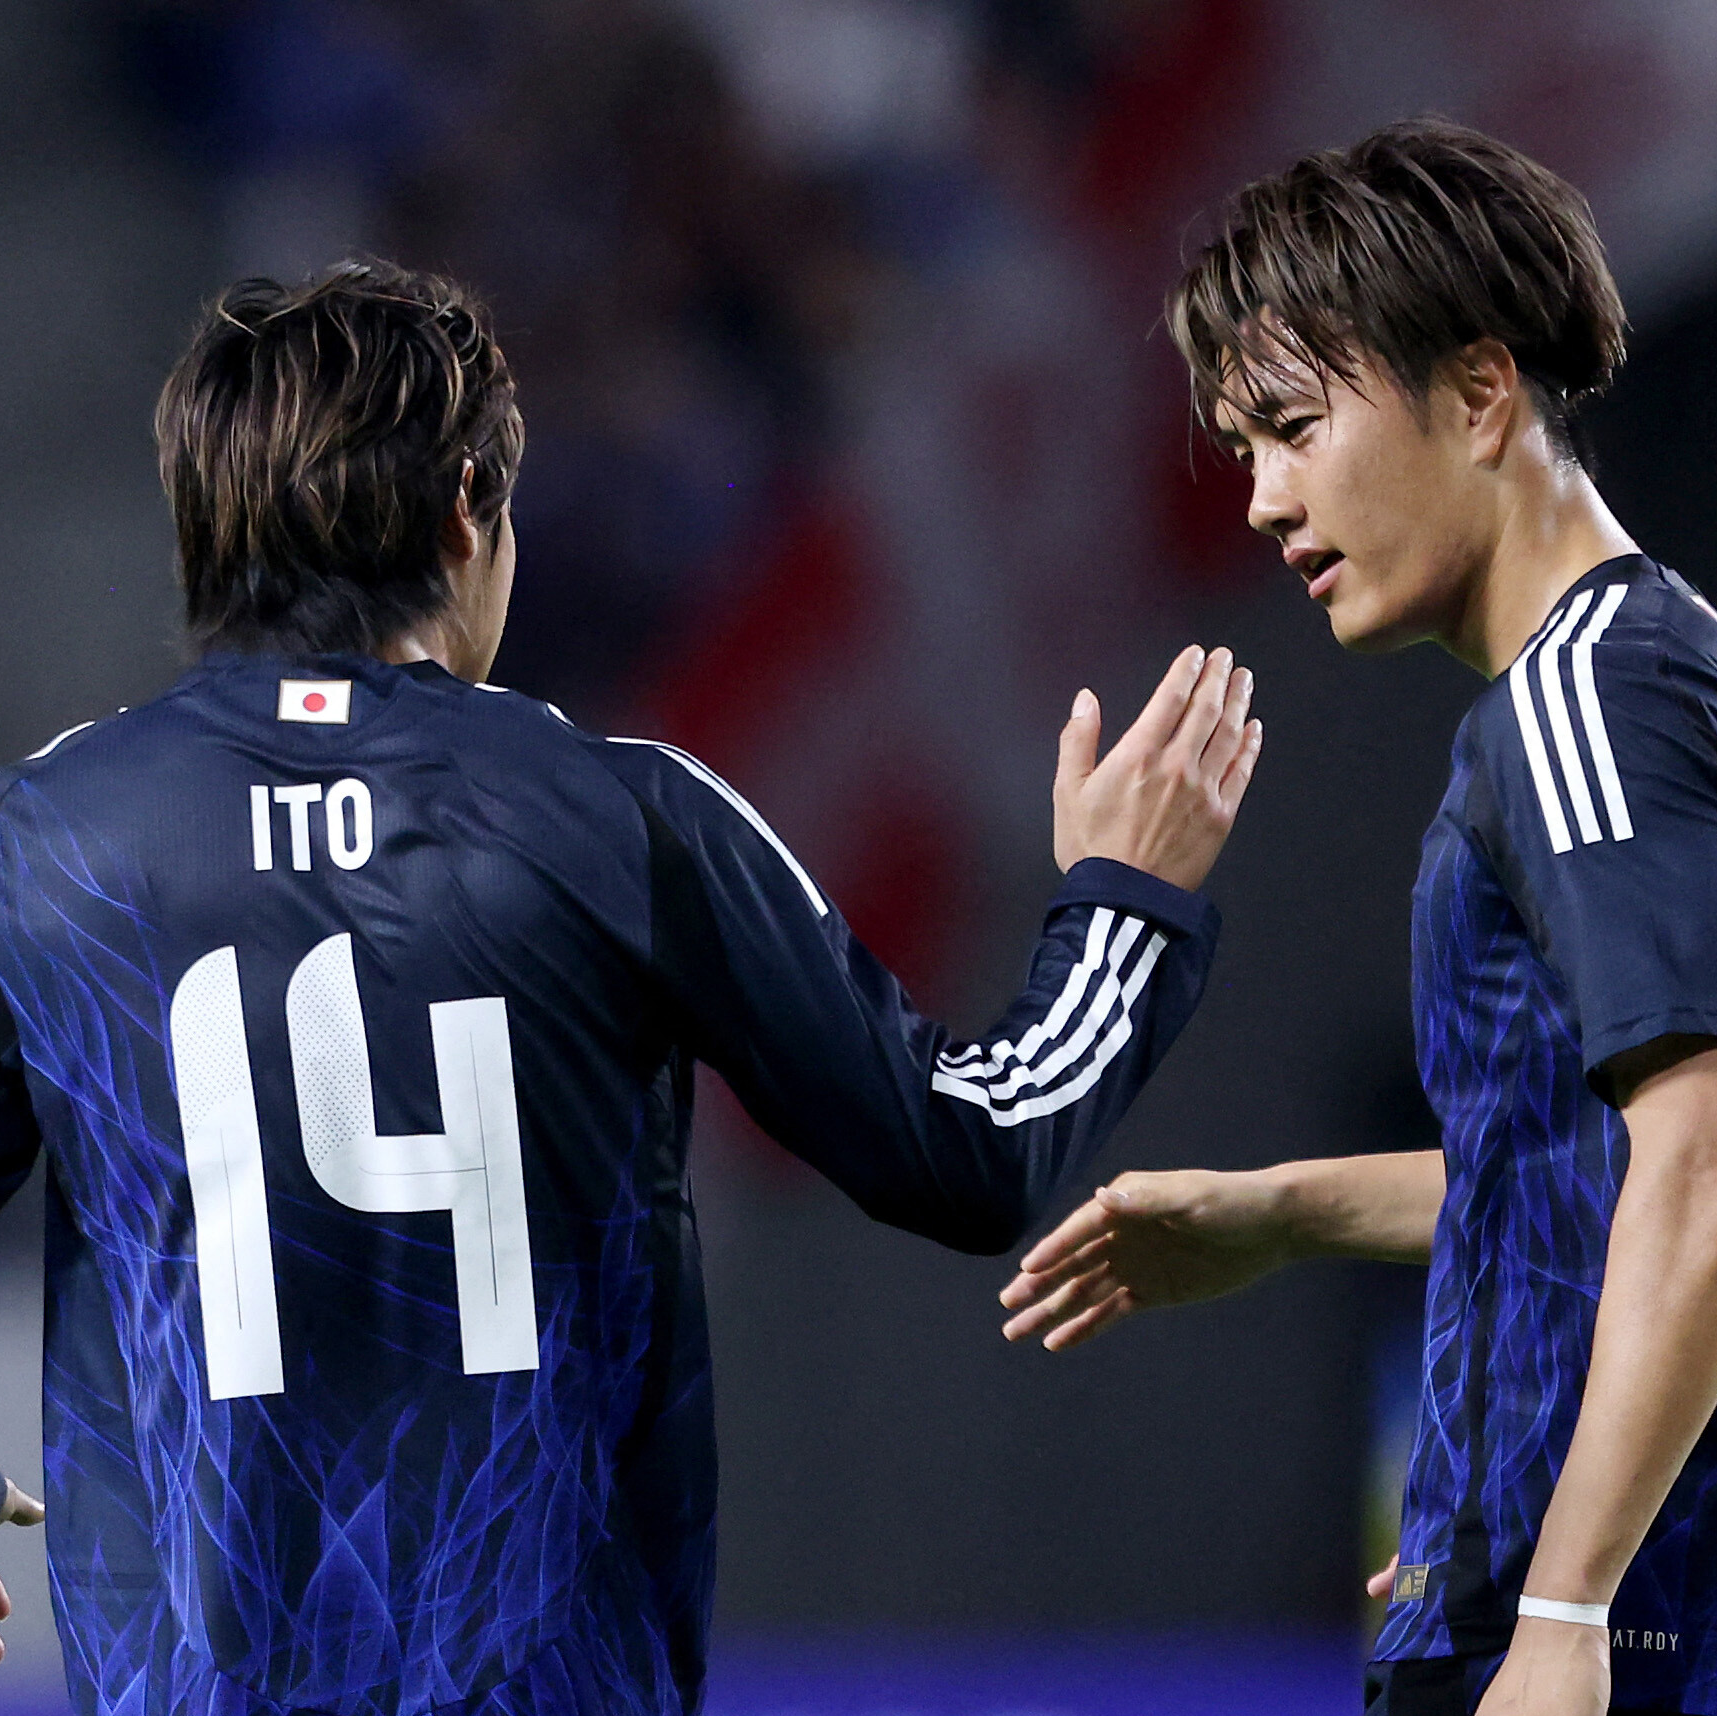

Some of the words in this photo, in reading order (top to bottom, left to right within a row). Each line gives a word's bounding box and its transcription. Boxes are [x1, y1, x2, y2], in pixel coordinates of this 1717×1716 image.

[250, 778, 374, 872] ITO
[170, 931, 540, 1400] 14
[1612, 1628, 1679, 1652] AT.RDY
